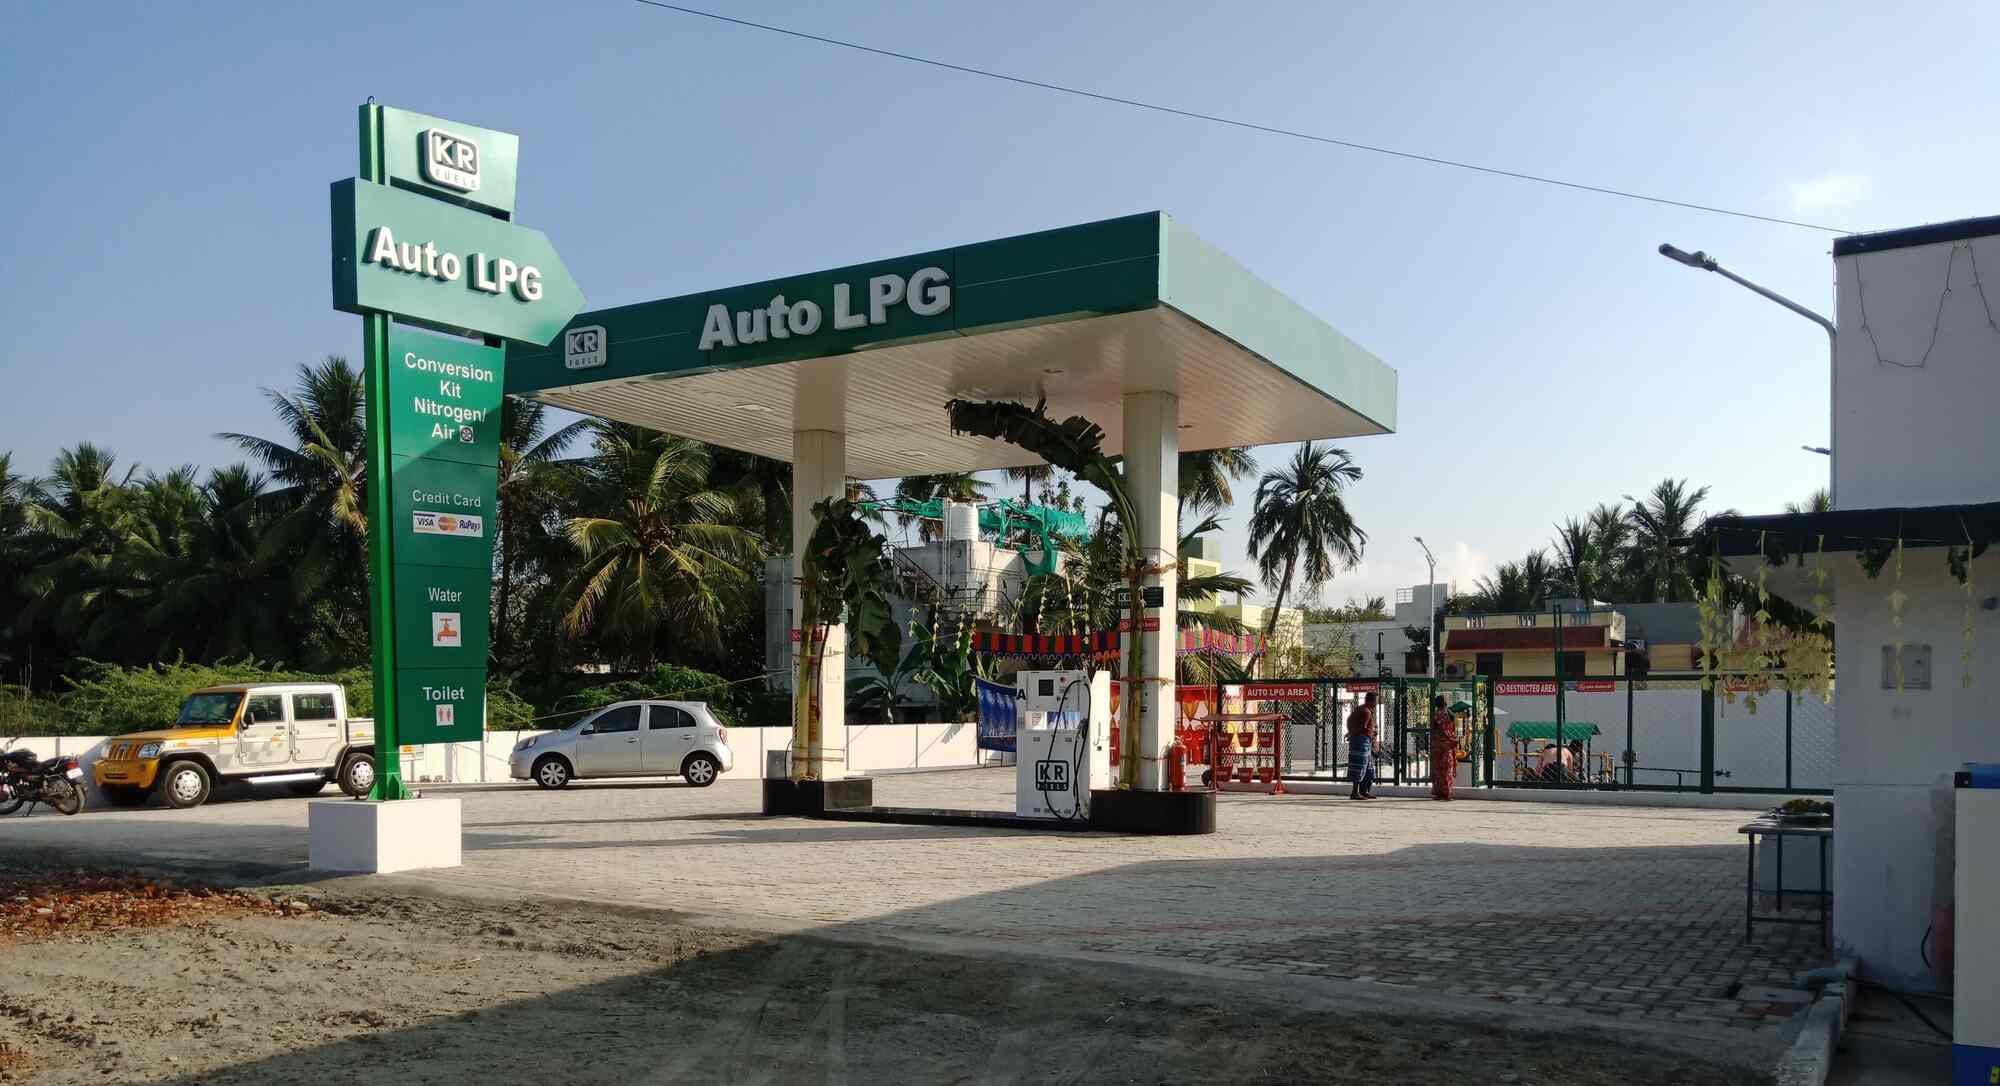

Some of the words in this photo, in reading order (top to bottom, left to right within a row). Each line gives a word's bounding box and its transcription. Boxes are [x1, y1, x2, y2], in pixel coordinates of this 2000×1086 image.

[432, 135, 476, 171] KR
[435, 168, 477, 188] FUELS
[366, 226, 460, 281] Auto
[470, 252, 543, 301] LPG
[698, 295, 822, 350] Auto
[833, 266, 951, 330] LPG
[569, 332, 599, 353] KR
[404, 352, 493, 383] Conversion
[440, 380, 462, 399] Kit
[431, 422, 454, 440] Air
[412, 489, 450, 505] Credit
[453, 493, 481, 508] Card
[416, 517, 434, 527] VISA
[459, 519, 480, 533] RuPay
[428, 587, 462, 602] Water
[422, 686, 464, 701] Toilet
[1016, 688, 1027, 701] A
[1247, 688, 1268, 697] AUTO
[1269, 688, 1286, 697] LPG
[1287, 687, 1310, 697] AREA
[1506, 683, 1540, 693] RESTRICTED
[1541, 683, 1556, 693] AREA
[1039, 764, 1064, 781] KR
